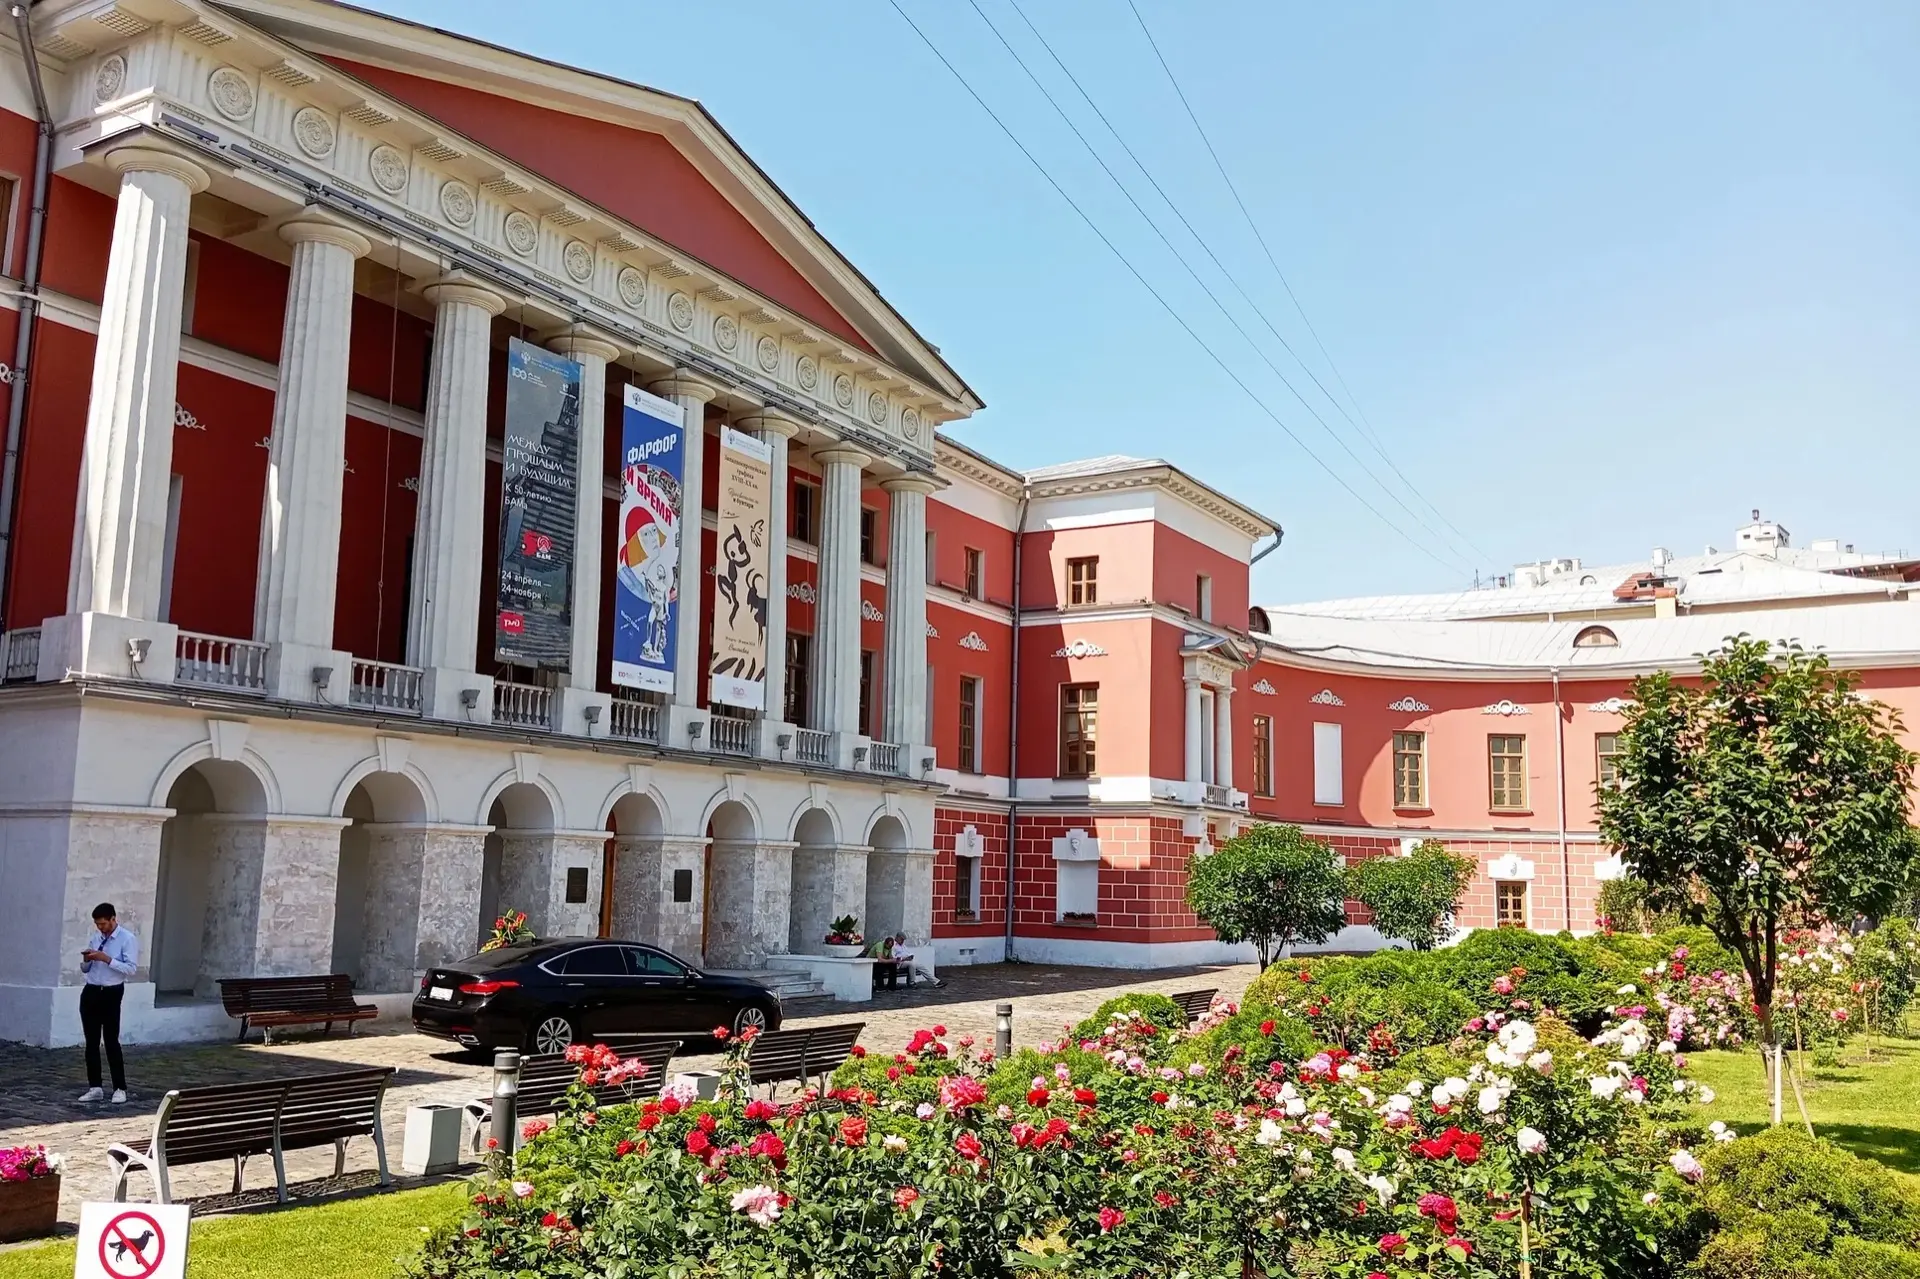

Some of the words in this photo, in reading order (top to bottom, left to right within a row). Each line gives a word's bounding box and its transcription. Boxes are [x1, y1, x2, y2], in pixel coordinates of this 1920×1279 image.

[507, 434, 550, 455] МЕЖДУ
[627, 433, 677, 464] ФАРФОР
[505, 461, 515, 473] И
[506, 447, 564, 473] ПРОШЛЫМ
[504, 496, 528, 510] БАМа
[505, 482, 512, 493] К
[514, 484, 552, 504] 50-летию
[626, 465, 634, 486] И
[637, 475, 672, 528] ВРЕМЯ
[536, 551, 551, 560] БАМ
[501, 570, 512, 580] 24
[514, 574, 542, 588] апреля
[501, 582, 511, 594] 24
[513, 587, 542, 601] ноября
